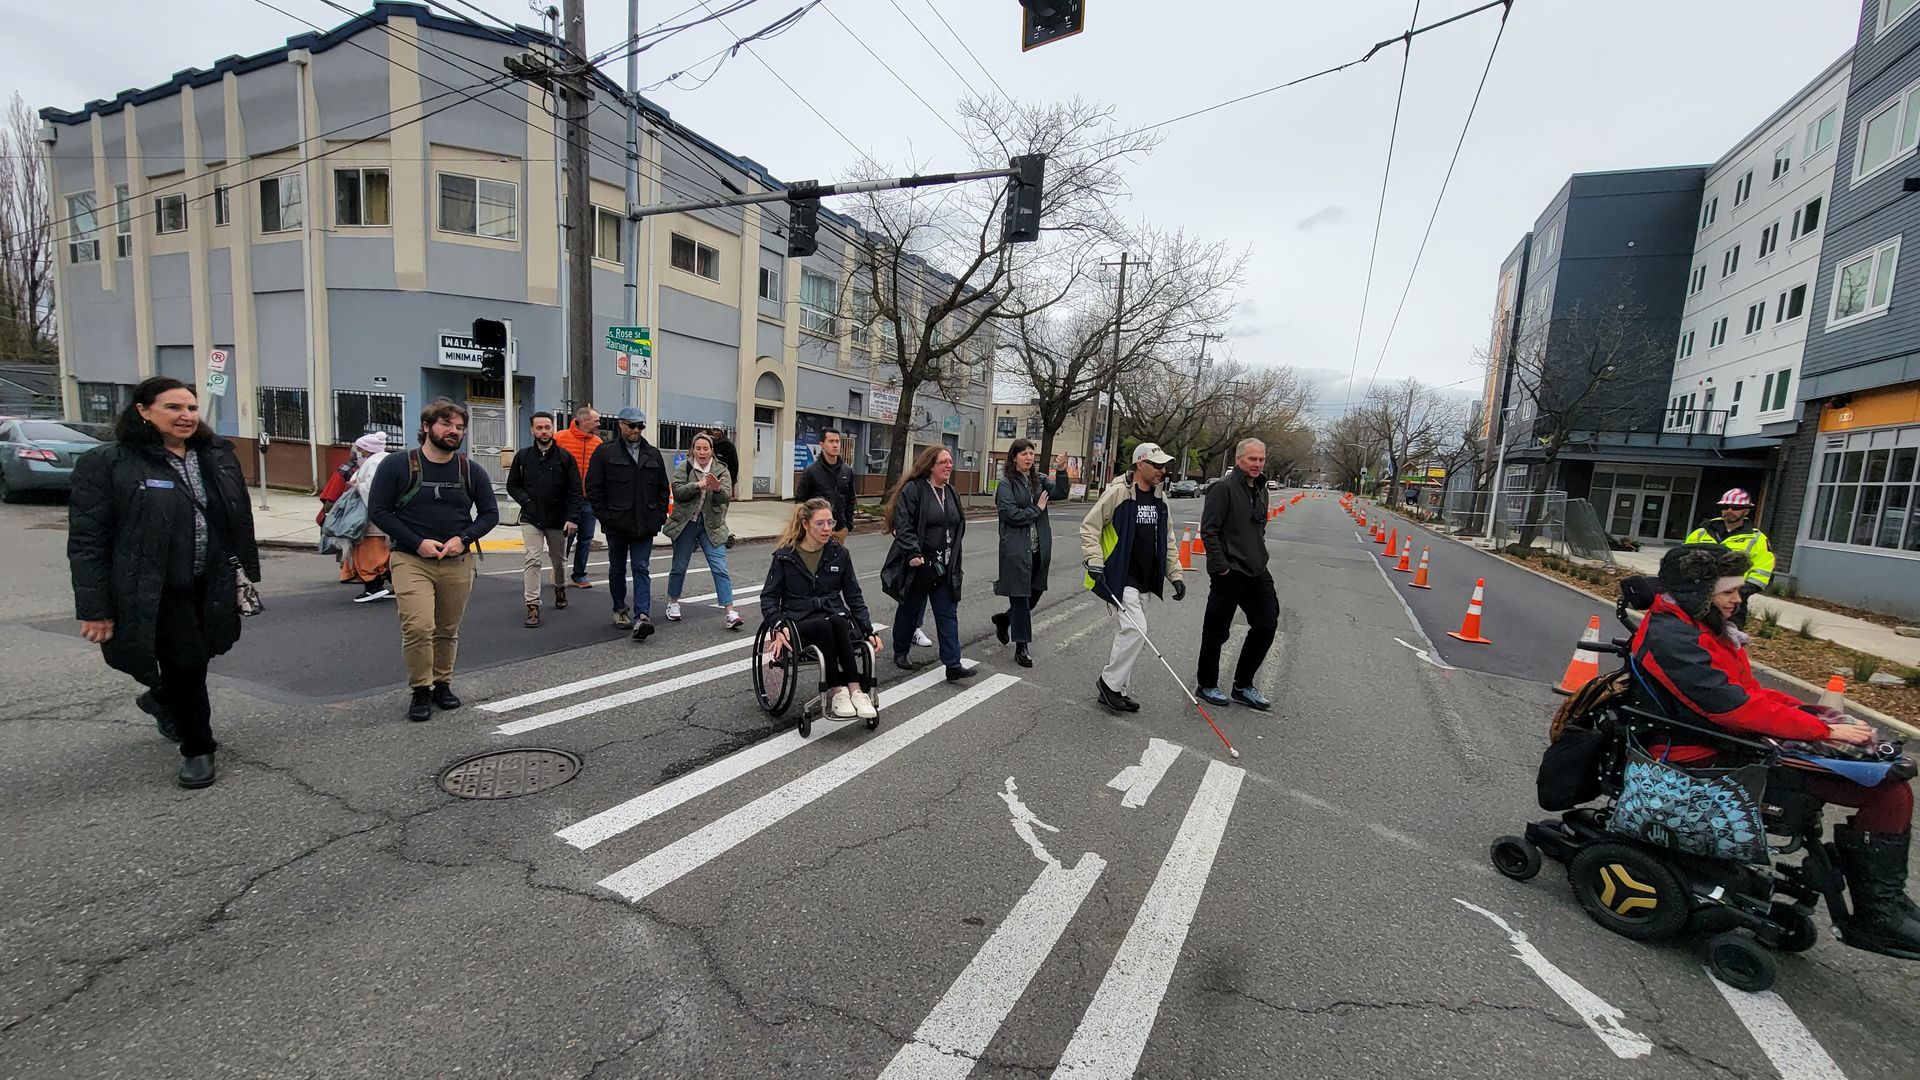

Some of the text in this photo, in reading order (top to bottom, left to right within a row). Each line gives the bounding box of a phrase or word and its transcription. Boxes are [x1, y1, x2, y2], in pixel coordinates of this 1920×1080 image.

[616, 328, 633, 338] Rose
[606, 338, 629, 351] Rainier
[445, 351, 483, 362] MINIMAR
